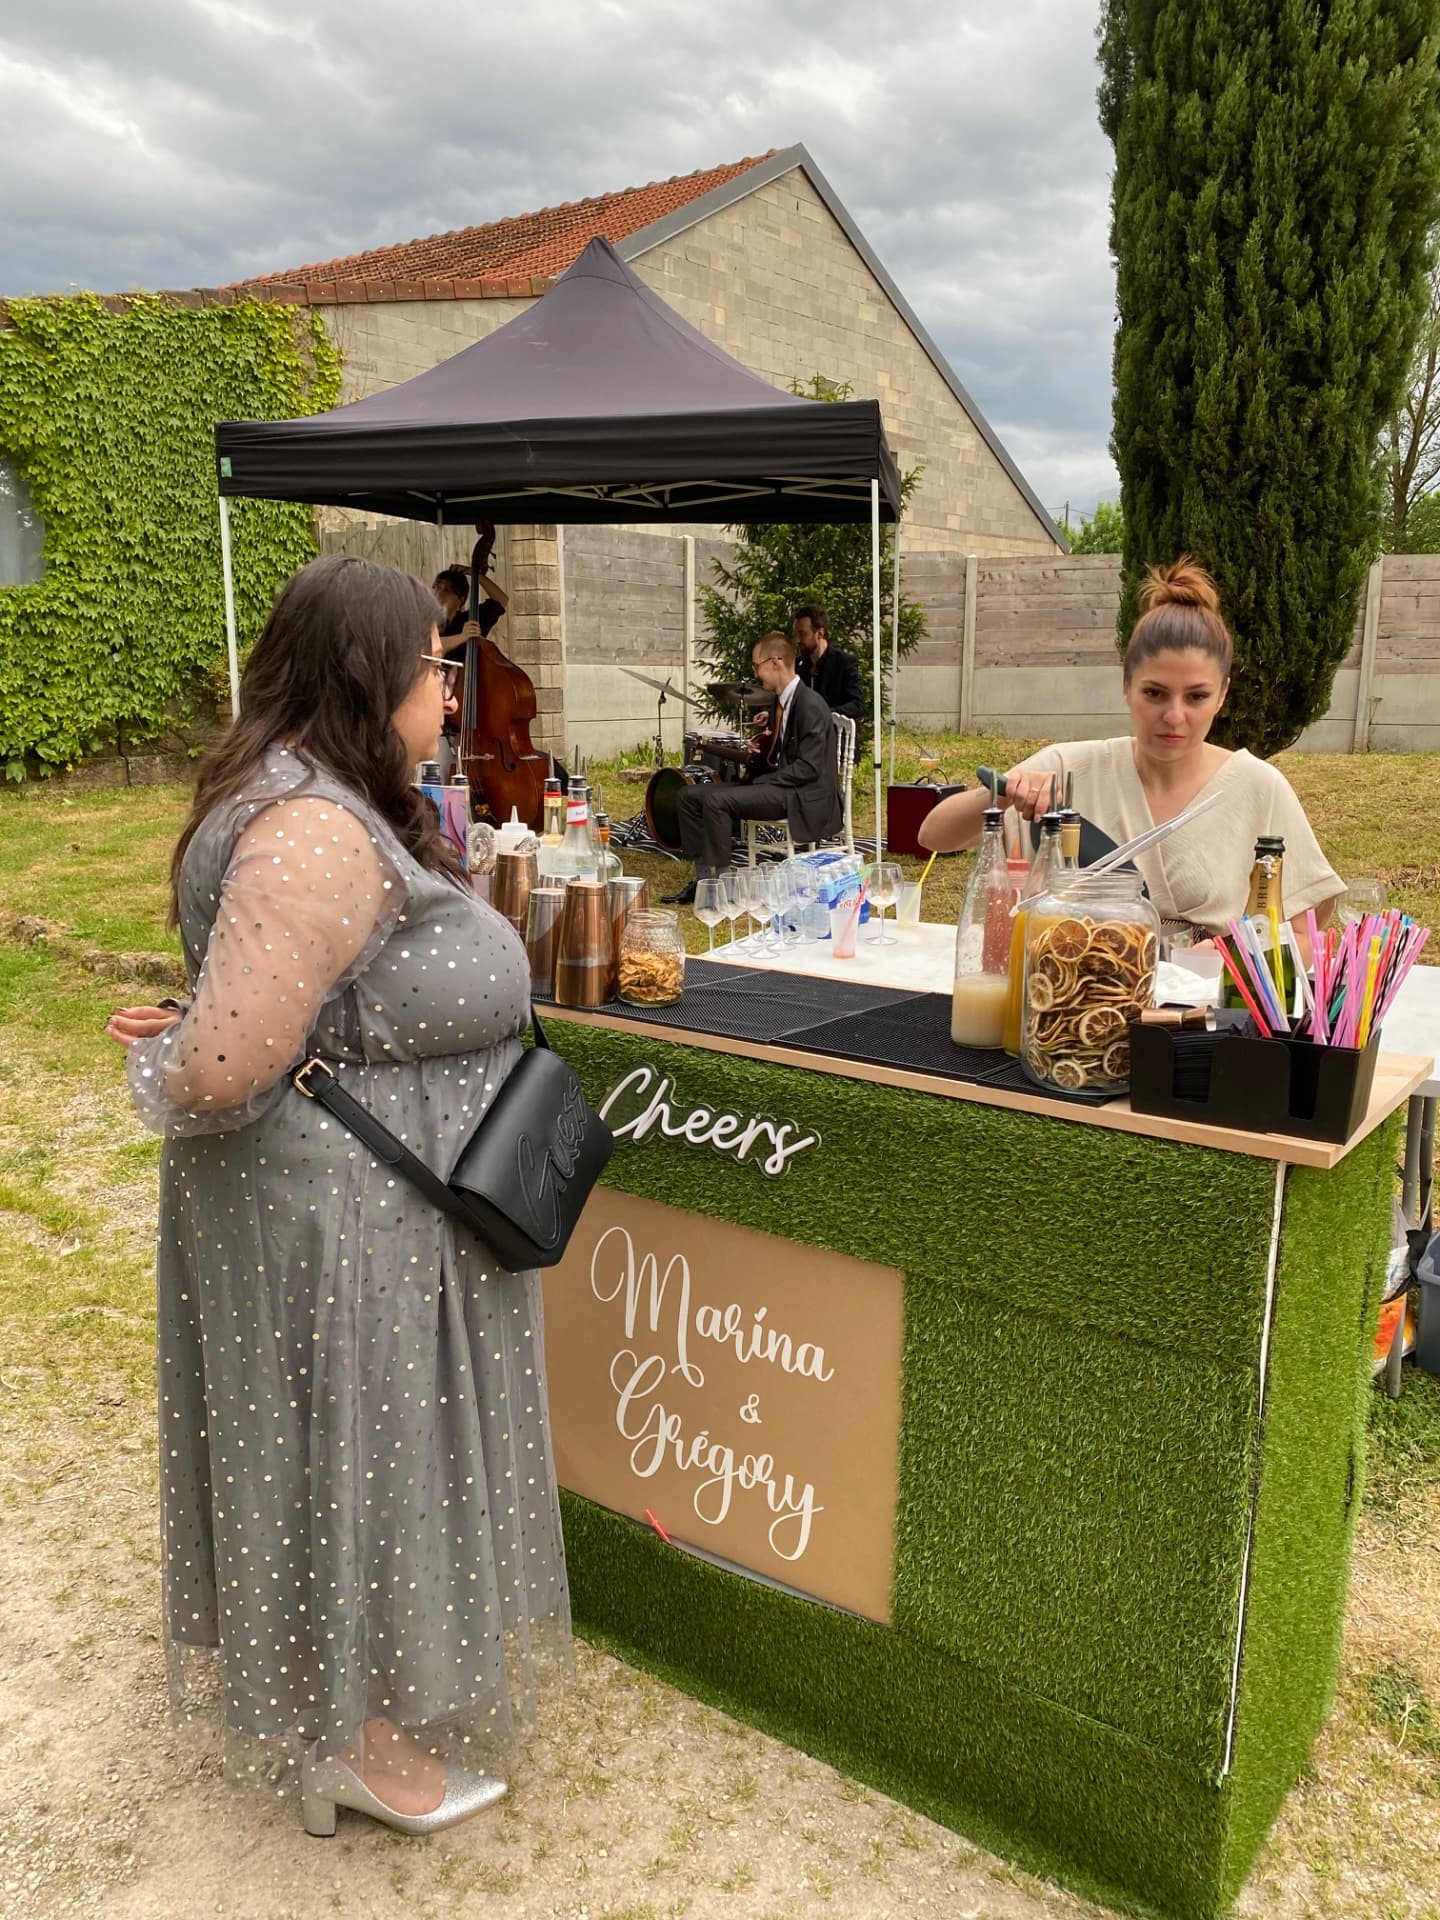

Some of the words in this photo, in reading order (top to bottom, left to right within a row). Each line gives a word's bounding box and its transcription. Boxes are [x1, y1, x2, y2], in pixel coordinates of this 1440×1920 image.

[1256, 872, 1269, 909] BRUT
[599, 1067, 815, 1175] Cheers
[591, 1226, 835, 1387] Marina
[610, 1349, 824, 1561] Grégory
[739, 1393, 763, 1424] &
